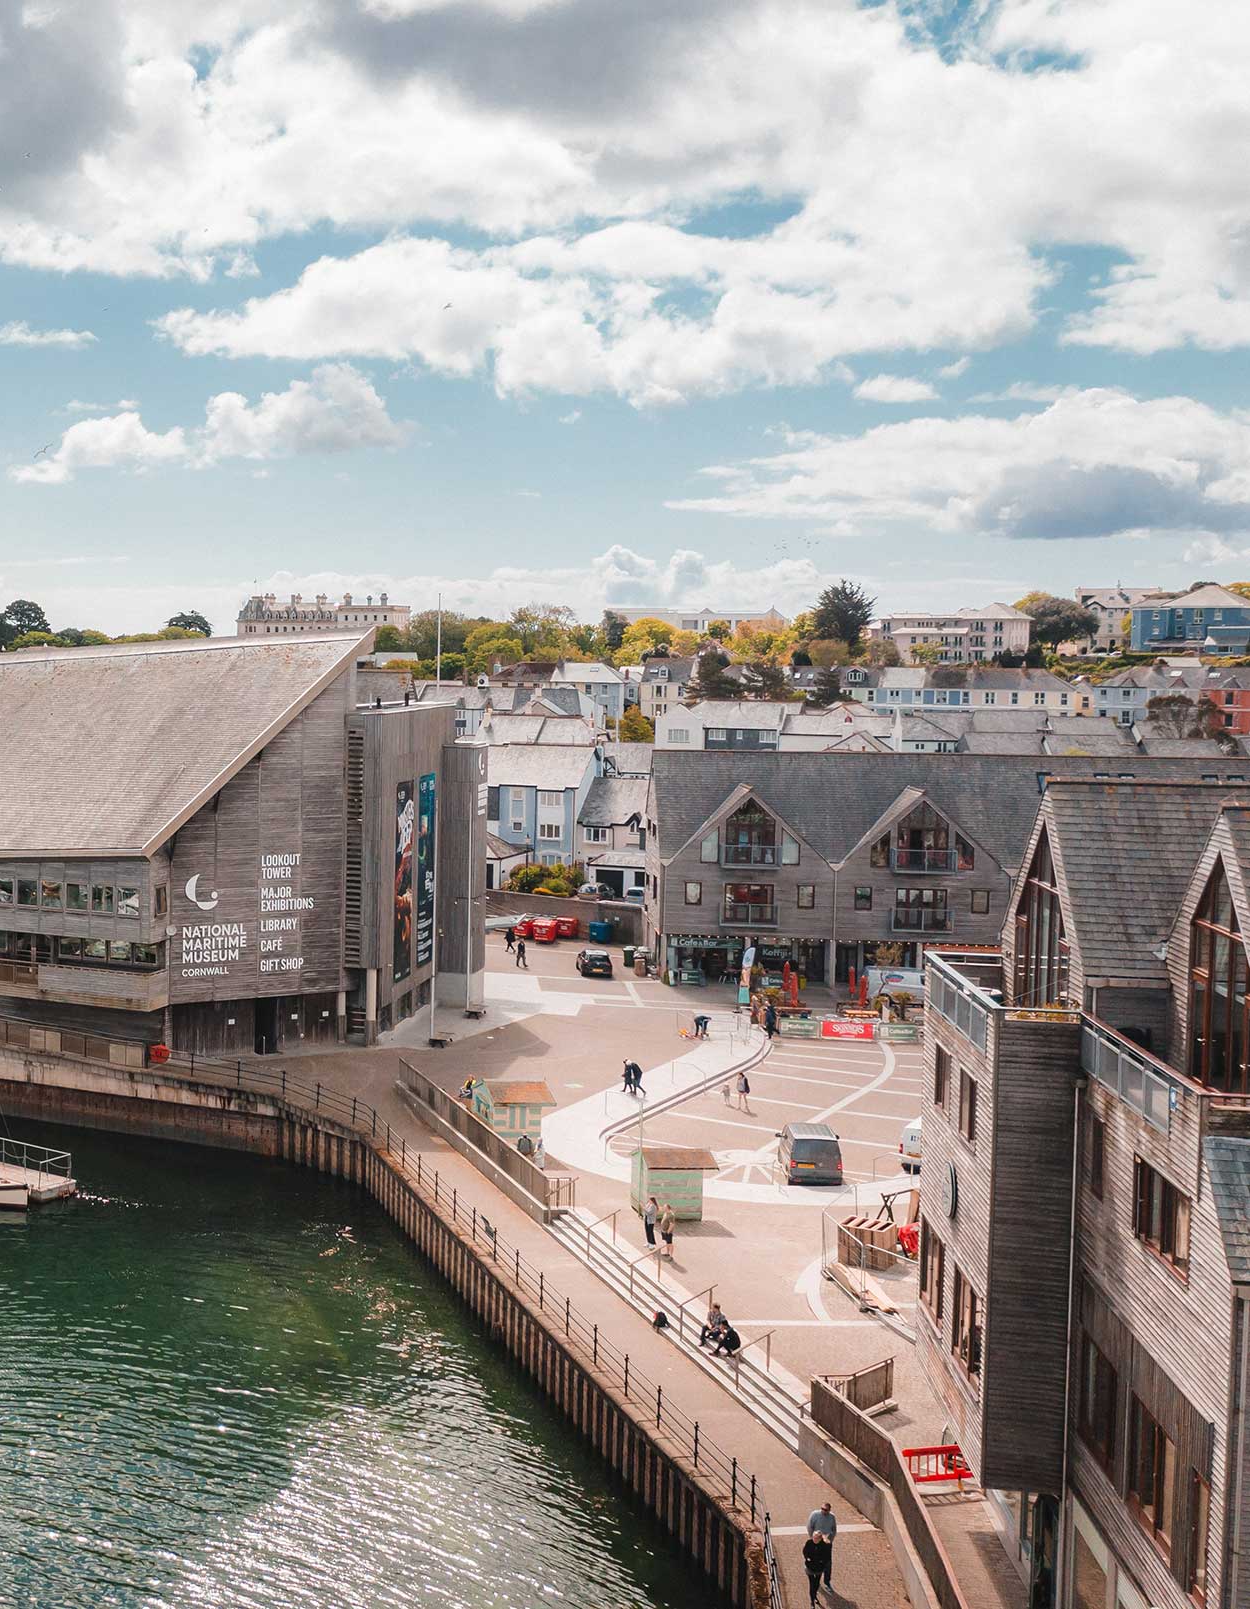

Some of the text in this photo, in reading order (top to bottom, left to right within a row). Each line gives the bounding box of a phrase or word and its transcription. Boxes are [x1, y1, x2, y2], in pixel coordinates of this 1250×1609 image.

[261, 853, 301, 867] LOOKOUT
[261, 866, 292, 879] TOWER
[261, 886, 292, 899] MAJOR
[261, 897, 314, 912] EXHIBITIONS
[182, 923, 247, 939] NATIONAL
[260, 918, 297, 932] LIBRARY
[182, 935, 247, 951] MARITIME
[260, 936, 283, 952] CAFÉ
[182, 949, 239, 964] MUSEUM
[181, 966, 230, 977] CORNWALL
[260, 957, 304, 972] GIFT SHOP
